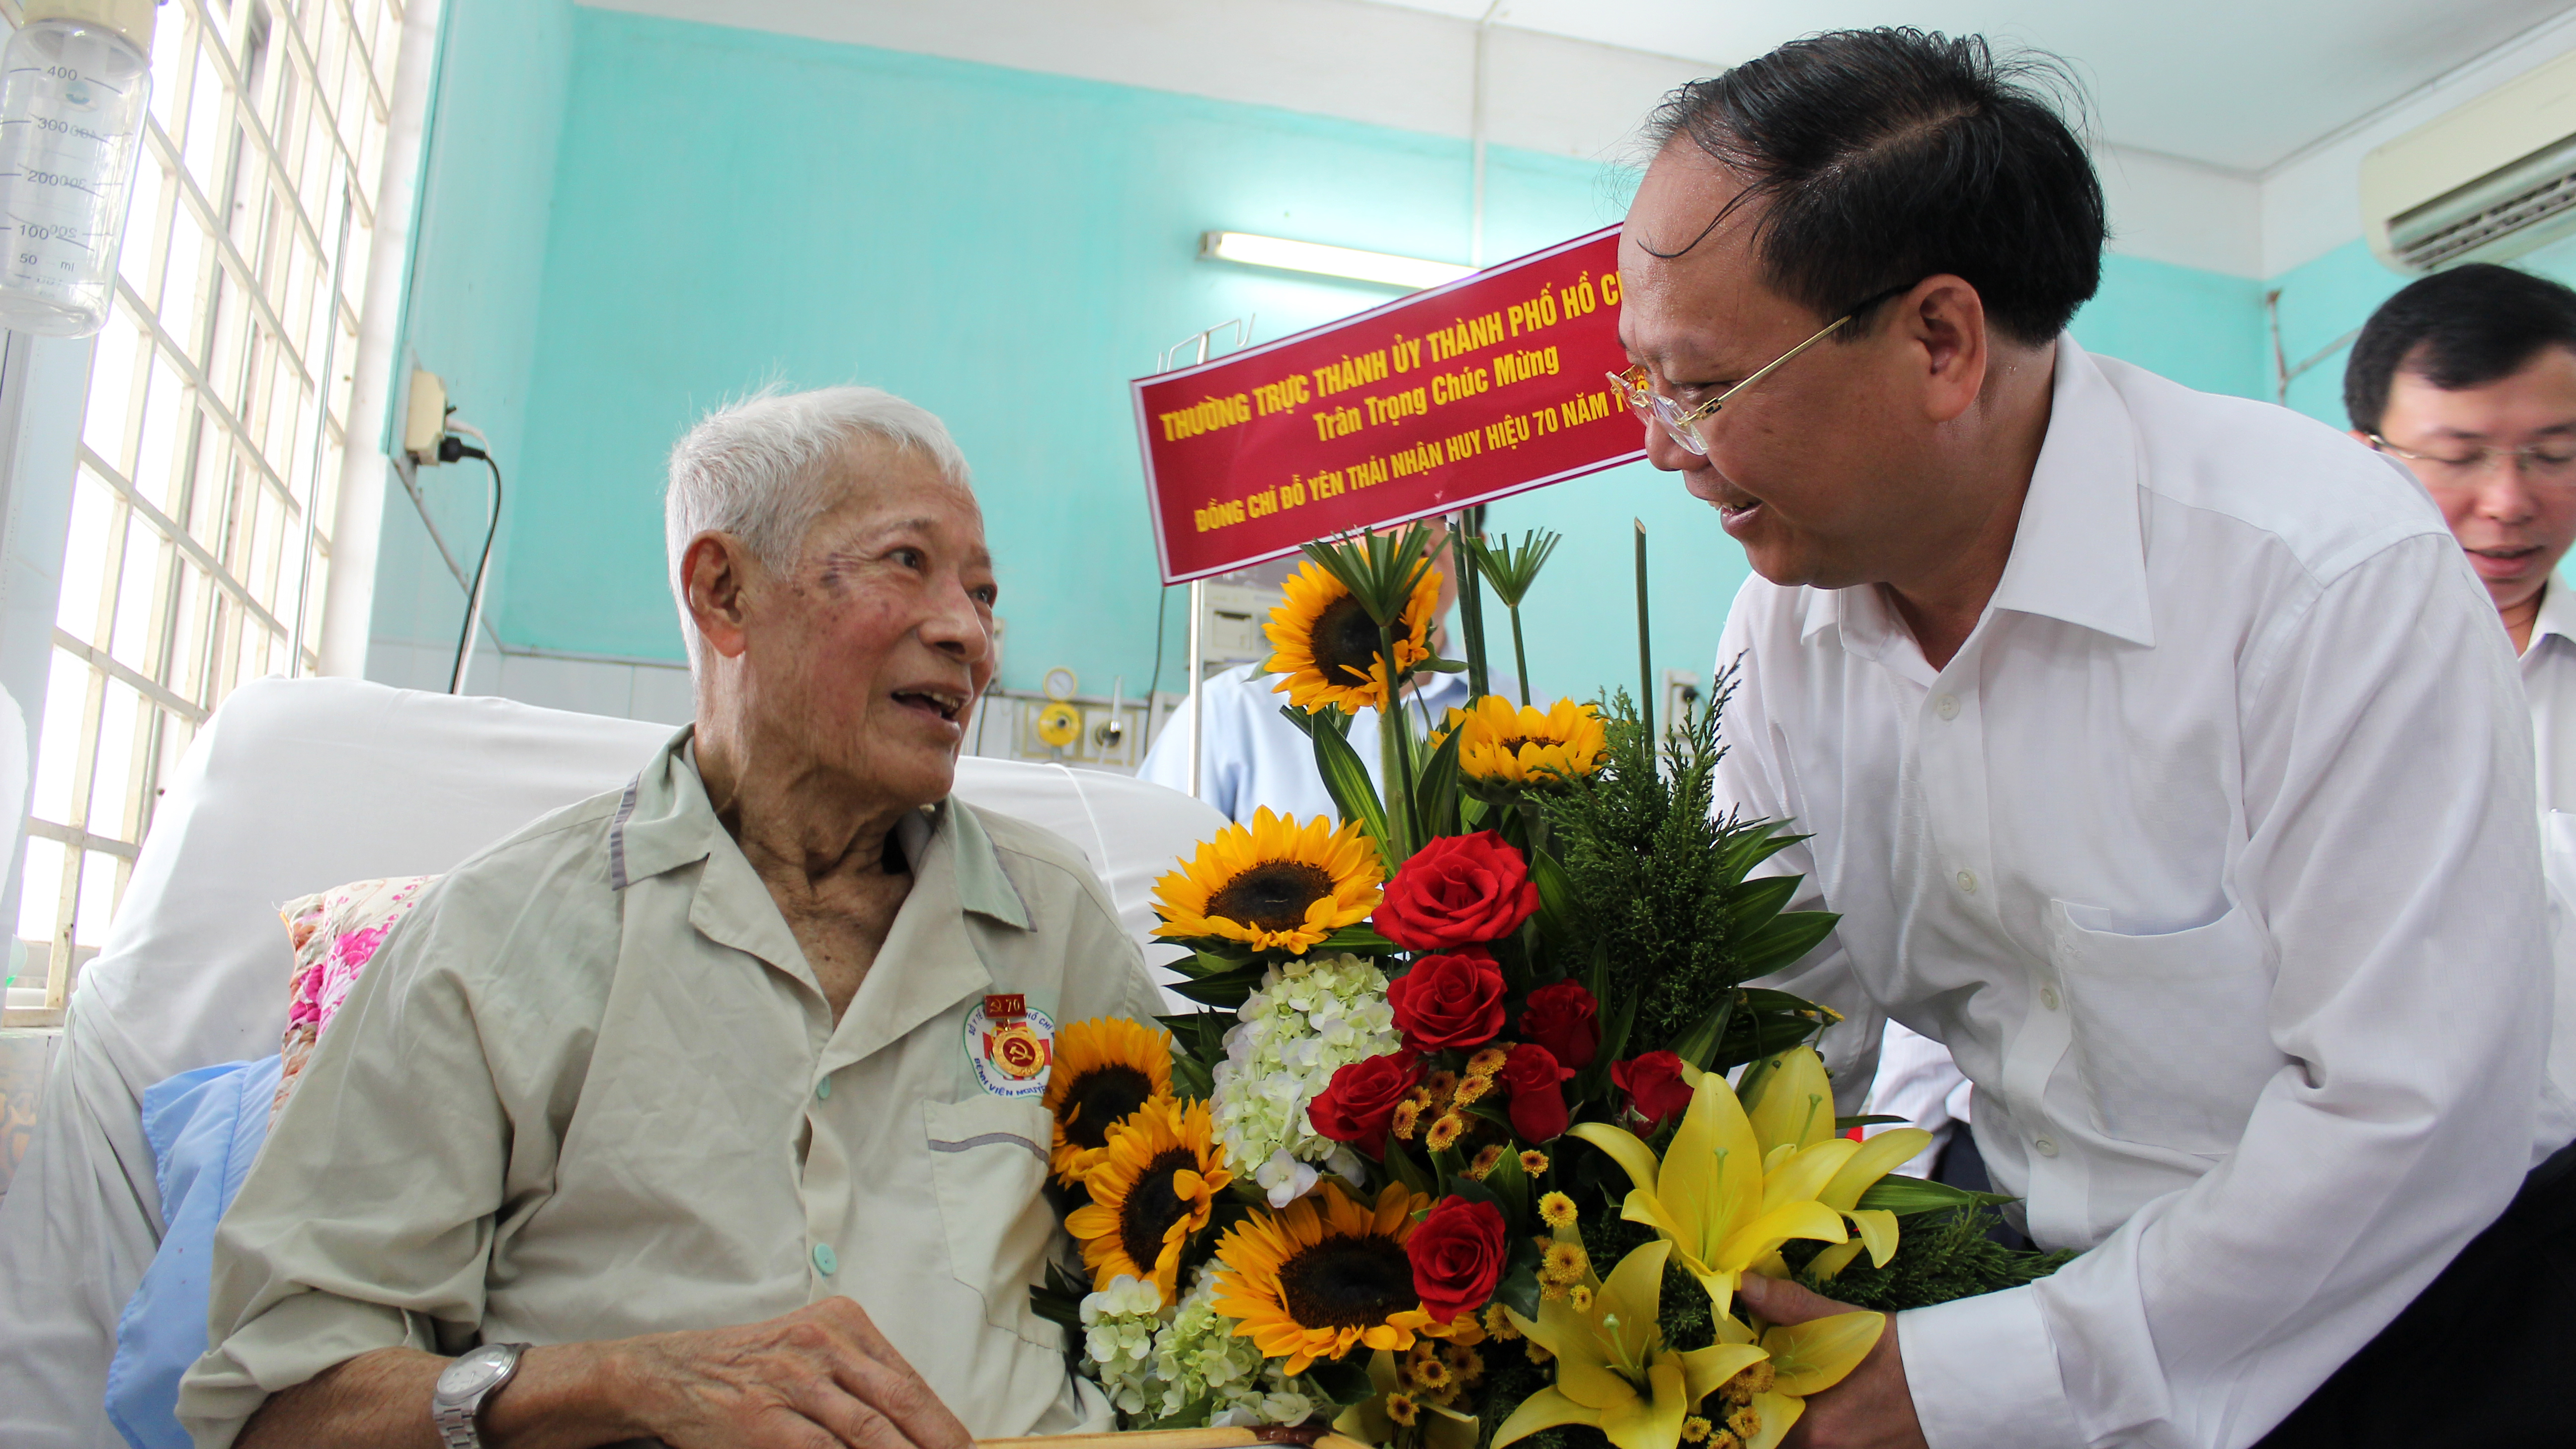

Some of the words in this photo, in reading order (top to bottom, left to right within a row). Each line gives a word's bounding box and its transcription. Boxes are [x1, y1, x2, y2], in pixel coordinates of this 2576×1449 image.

[47, 66, 77, 80] 400
[38, 118, 68, 133] 300
[28, 170, 58, 186] 200
[20, 225, 49, 240] 100
[20, 253, 37, 265] 50
[61, 261, 75, 272] ml
[1160, 394, 1252, 441] THƯỜNG
[1252, 374, 1310, 415] TRỰC
[1312, 349, 1389, 398] THÀNH
[1391, 333, 1421, 374] ỦY
[1426, 317, 1504, 363] THÀNH
[1507, 282, 1558, 337] PHỐ
[1560, 270, 1597, 320] HỒ
[1364, 387, 1428, 426] Trọng
[1431, 366, 1489, 405] Chúc
[1493, 345, 1560, 388] Mừng
[1195, 497, 1246, 533] ĐỒNG
[1307, 470, 1346, 501] YÊN
[1389, 441, 1445, 478] NHẬN
[1445, 429, 1482, 462] HUY
[1485, 414, 1530, 450] HIỆU
[1532, 407, 1559, 436] 70
[1560, 392, 1610, 428] NĂM
[1005, 999, 1020, 1012] 70
[989, 1083, 1013, 1096] VIỆN
